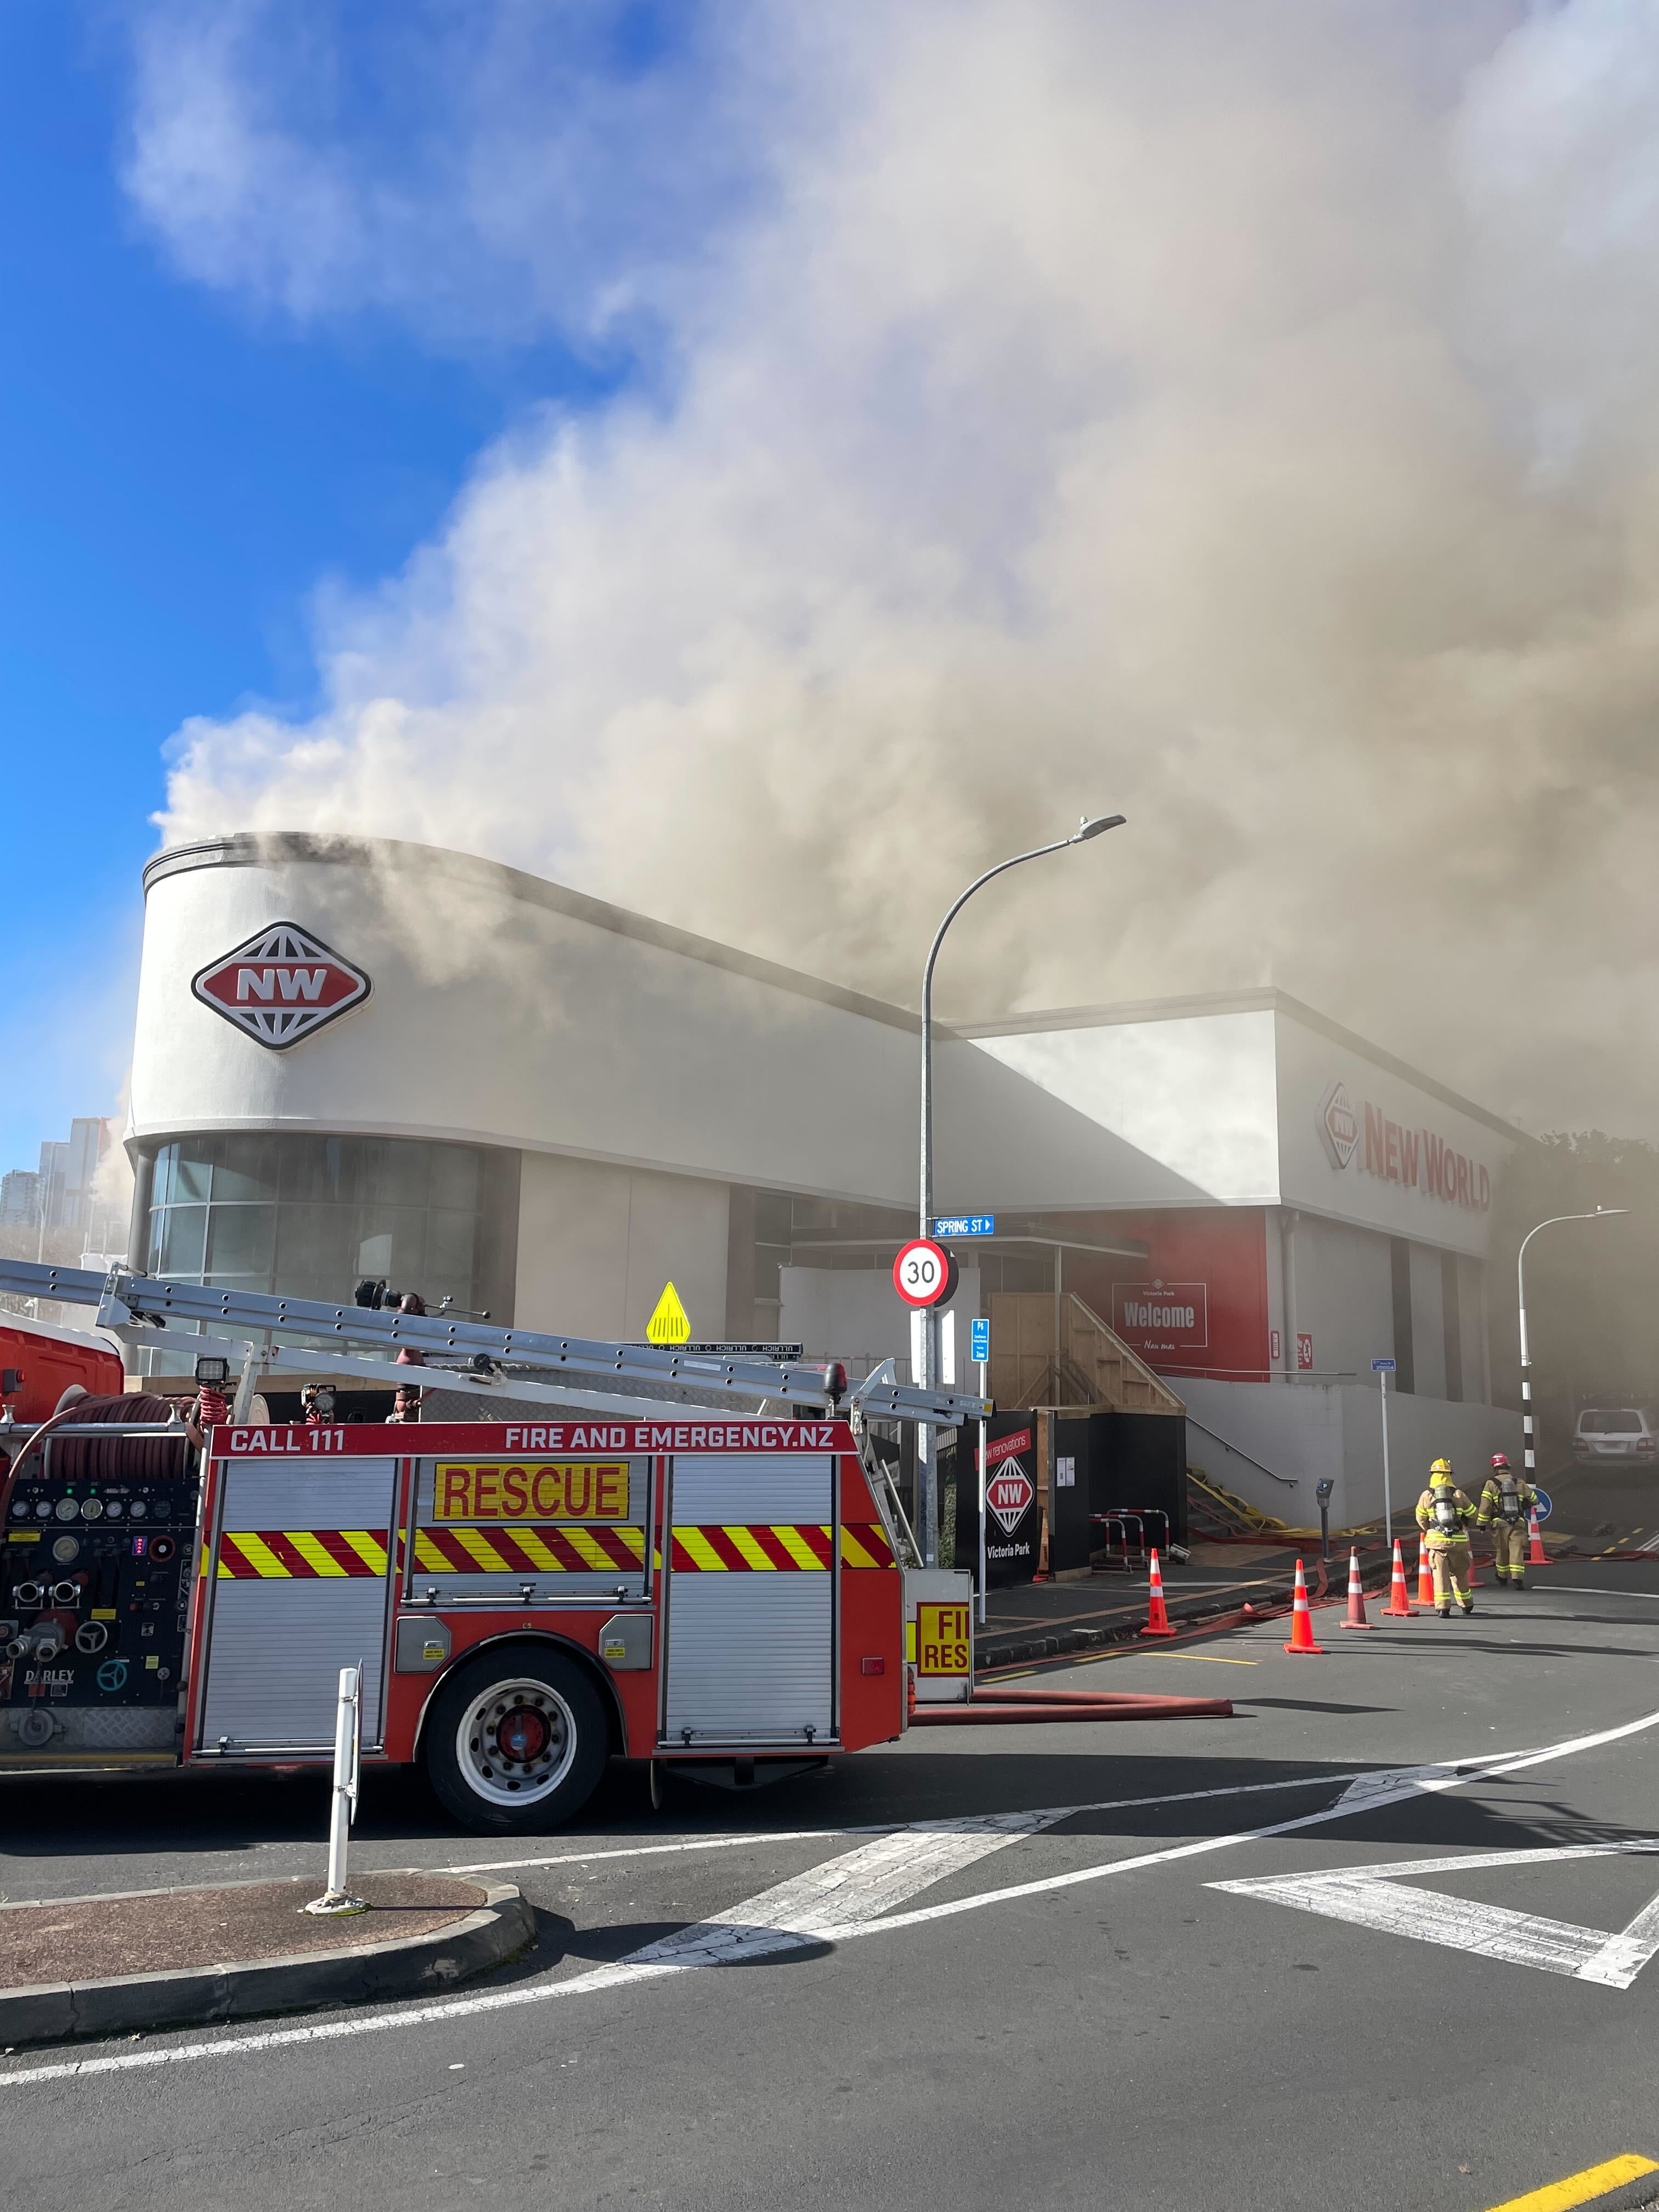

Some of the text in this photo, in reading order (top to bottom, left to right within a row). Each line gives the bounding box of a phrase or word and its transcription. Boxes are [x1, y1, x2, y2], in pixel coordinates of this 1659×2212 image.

[236, 969, 328, 1001] NW
[1334, 1110, 1353, 1137] NW
[1363, 1101, 1491, 1212] NEW WORLD
[936, 1219, 983, 1233] SPRING ST
[907, 1260, 935, 1284] 30
[1124, 1302, 1194, 1328] Welcome
[230, 1429, 345, 1452] CALL 111
[505, 1426, 834, 1448] FIRE AND EMERGENCY.NZ
[992, 1435, 1026, 1457] renovations
[443, 1467, 620, 1517] RESCUE
[997, 1483, 1023, 1505] NW
[987, 1543, 1014, 1559] Victoria
[1014, 1542, 1030, 1556] Park
[924, 1644, 967, 1668] RES
